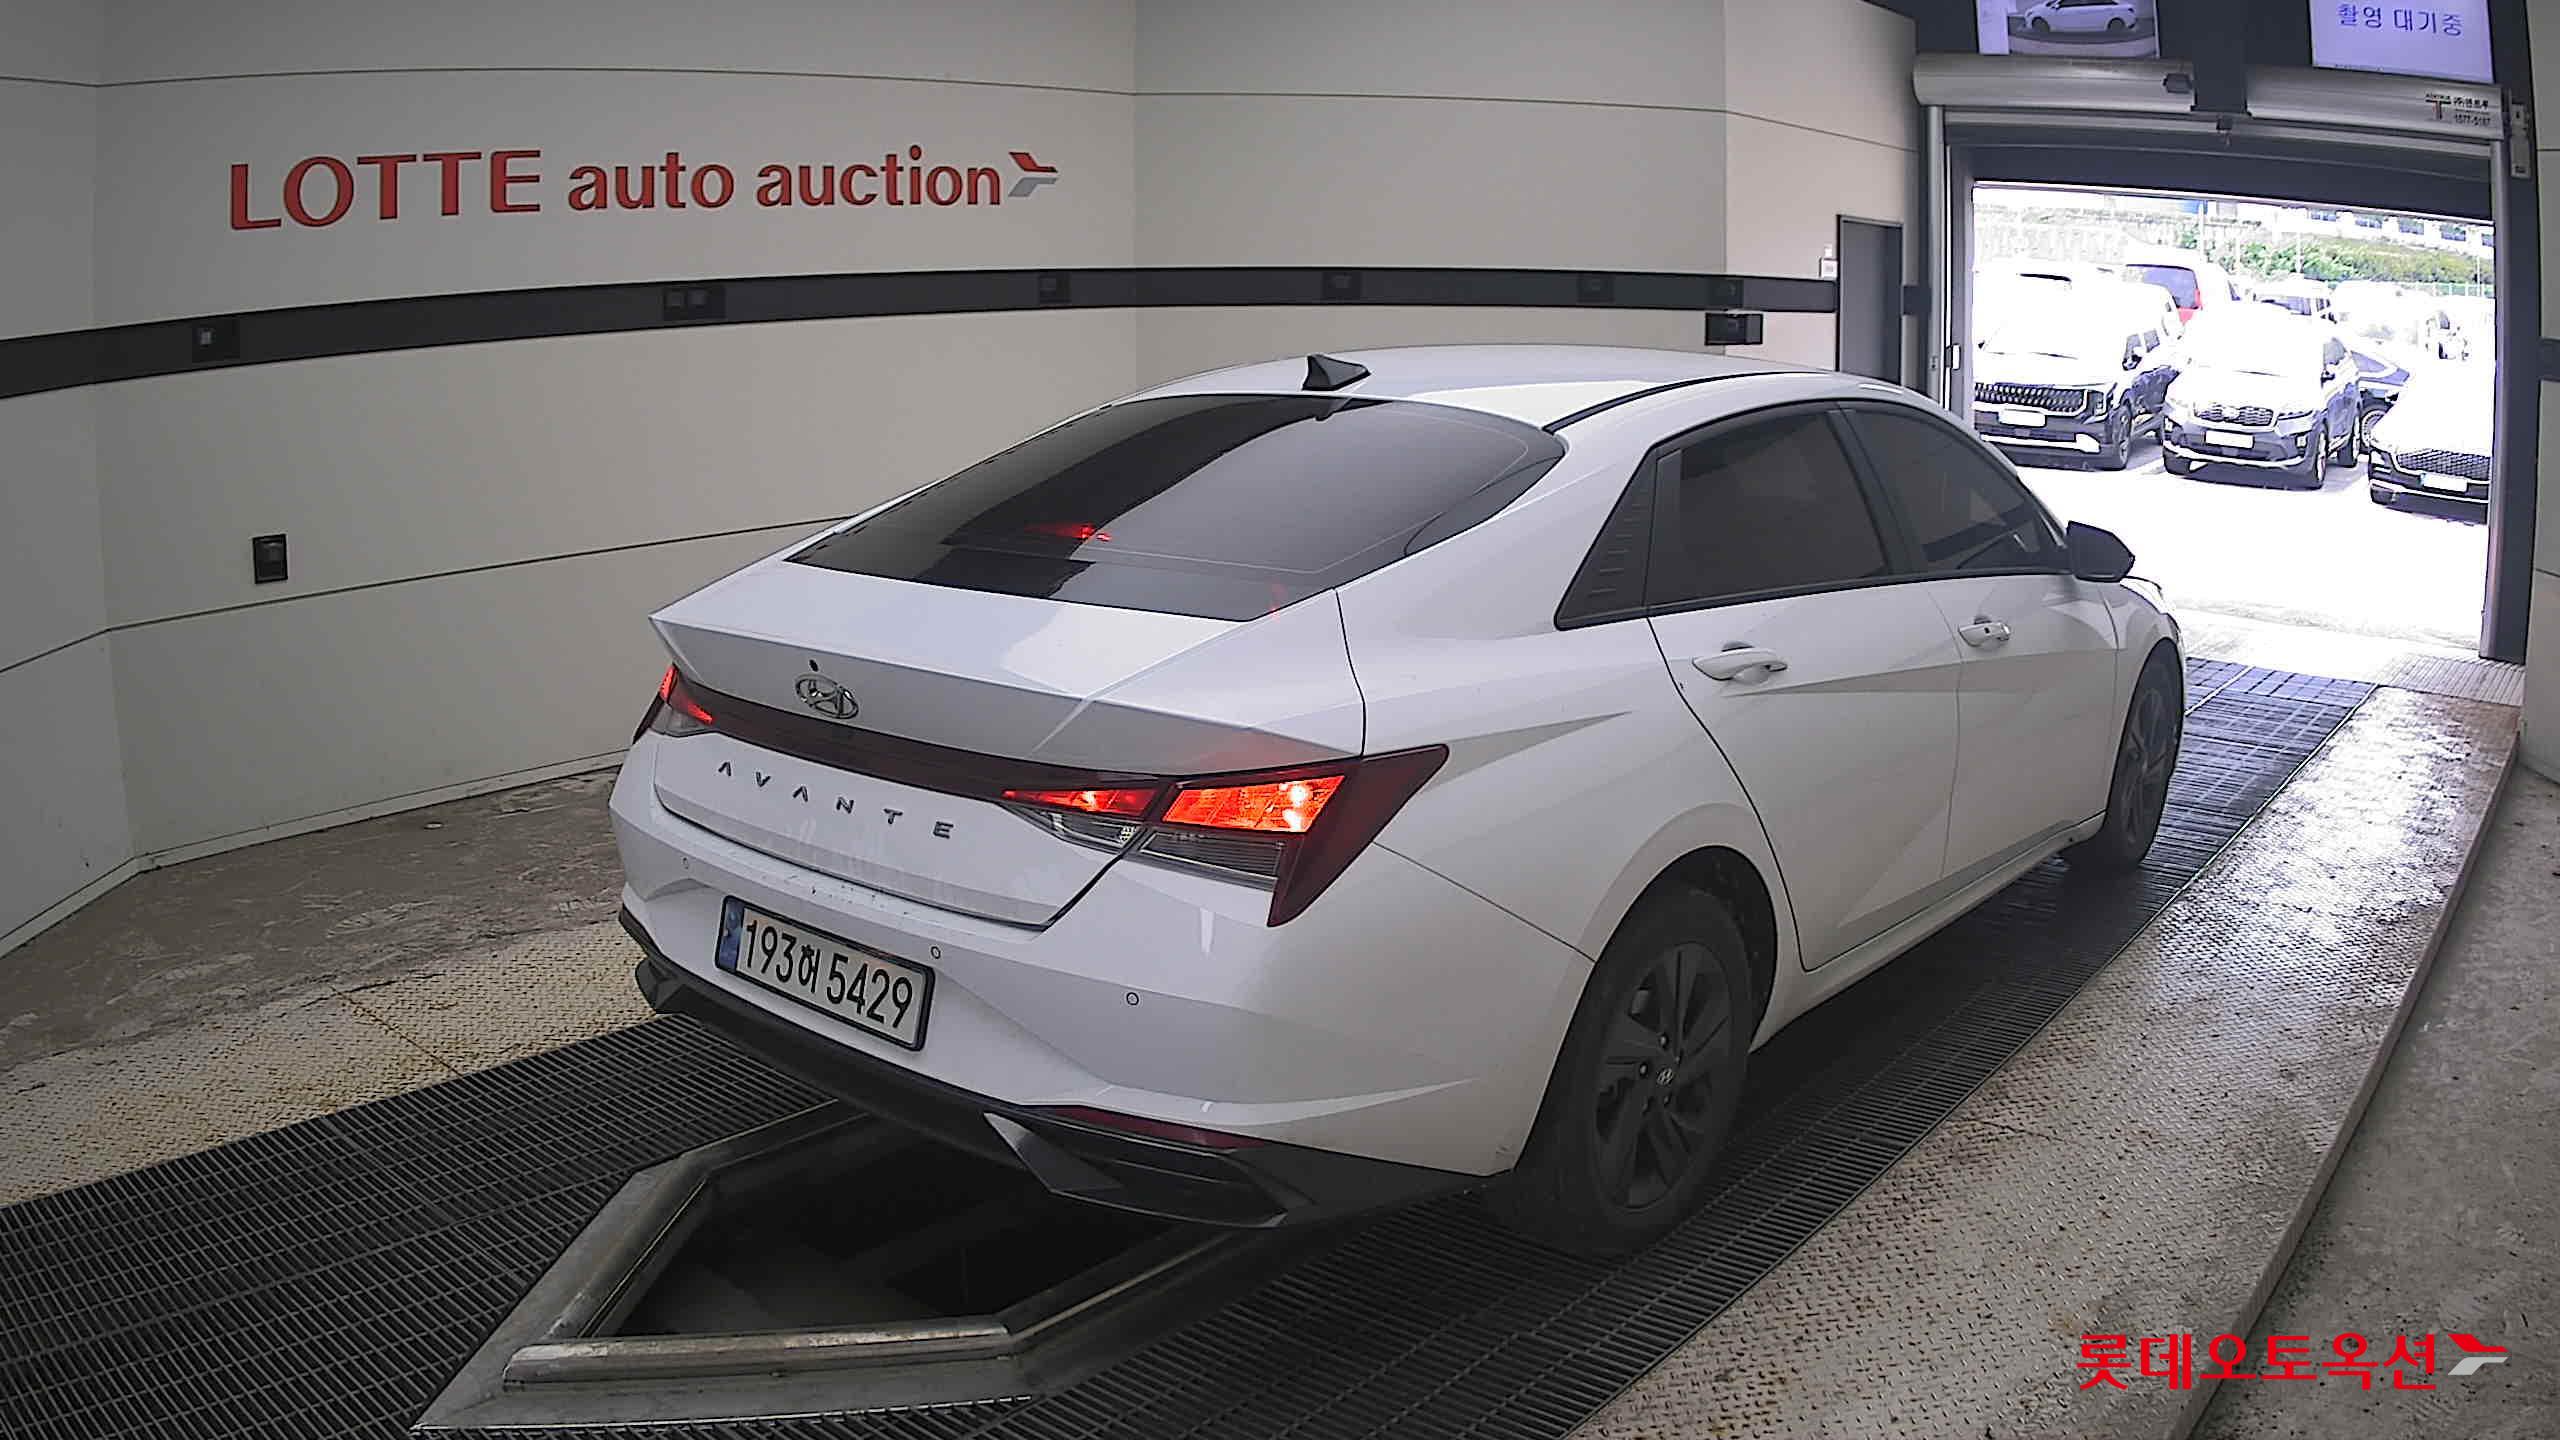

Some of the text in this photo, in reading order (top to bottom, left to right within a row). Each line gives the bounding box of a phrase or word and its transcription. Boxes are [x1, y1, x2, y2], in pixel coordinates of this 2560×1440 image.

[2393, 8, 2464, 36] 대기중
[230, 145, 1001, 231] LOTTE auto auction
[718, 761, 954, 838] AVANTE
